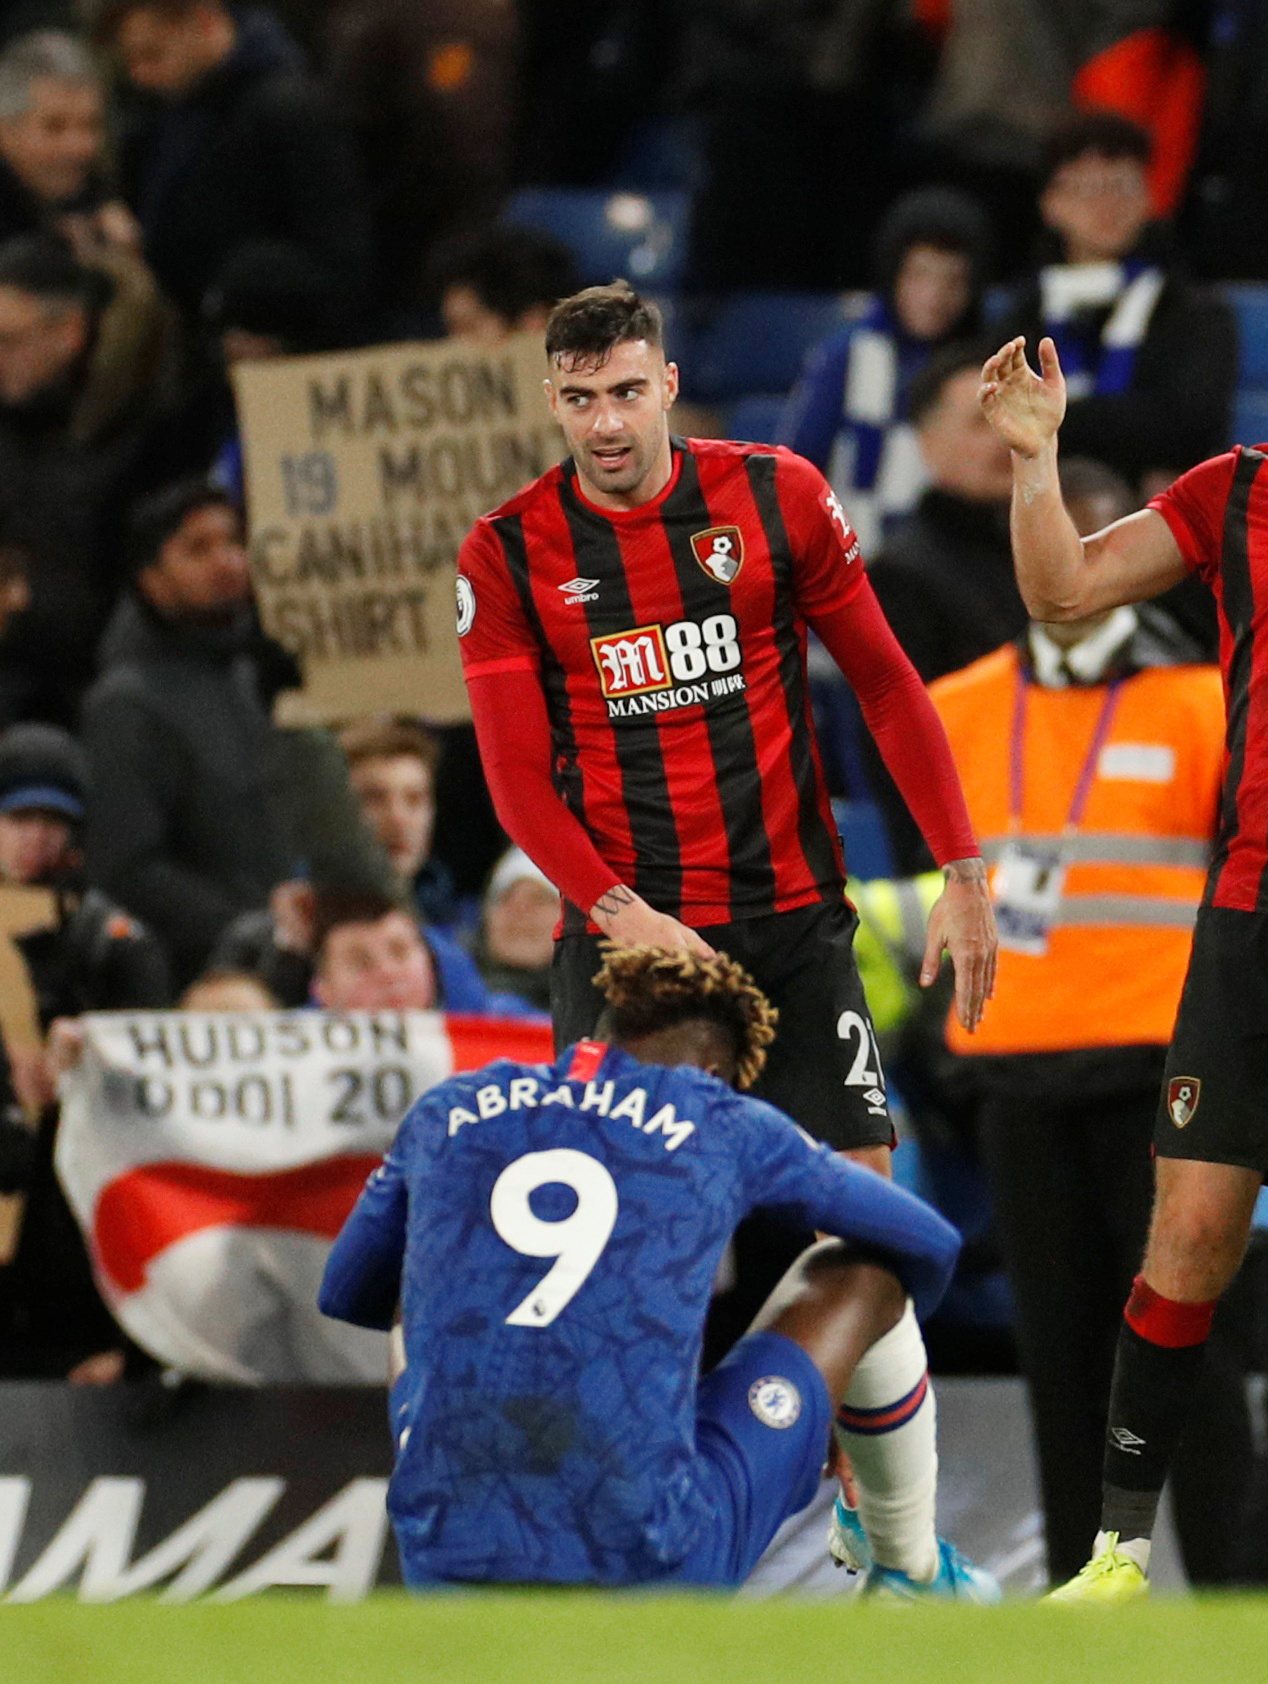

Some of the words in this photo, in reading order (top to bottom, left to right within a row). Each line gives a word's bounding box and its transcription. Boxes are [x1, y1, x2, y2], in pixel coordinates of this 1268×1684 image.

[307, 360, 518, 438] MASON
[280, 450, 339, 517] 19
[274, 587, 429, 657] SHIRT
[564, 592, 600, 606] umbro
[606, 682, 709, 718] MANSION
[128, 1016, 410, 1069] HUDSON
[837, 1010, 886, 1091] 2
[327, 1063, 413, 1124] 20
[447, 1079, 695, 1151] ABRAHAM
[490, 1148, 618, 1328] 9
